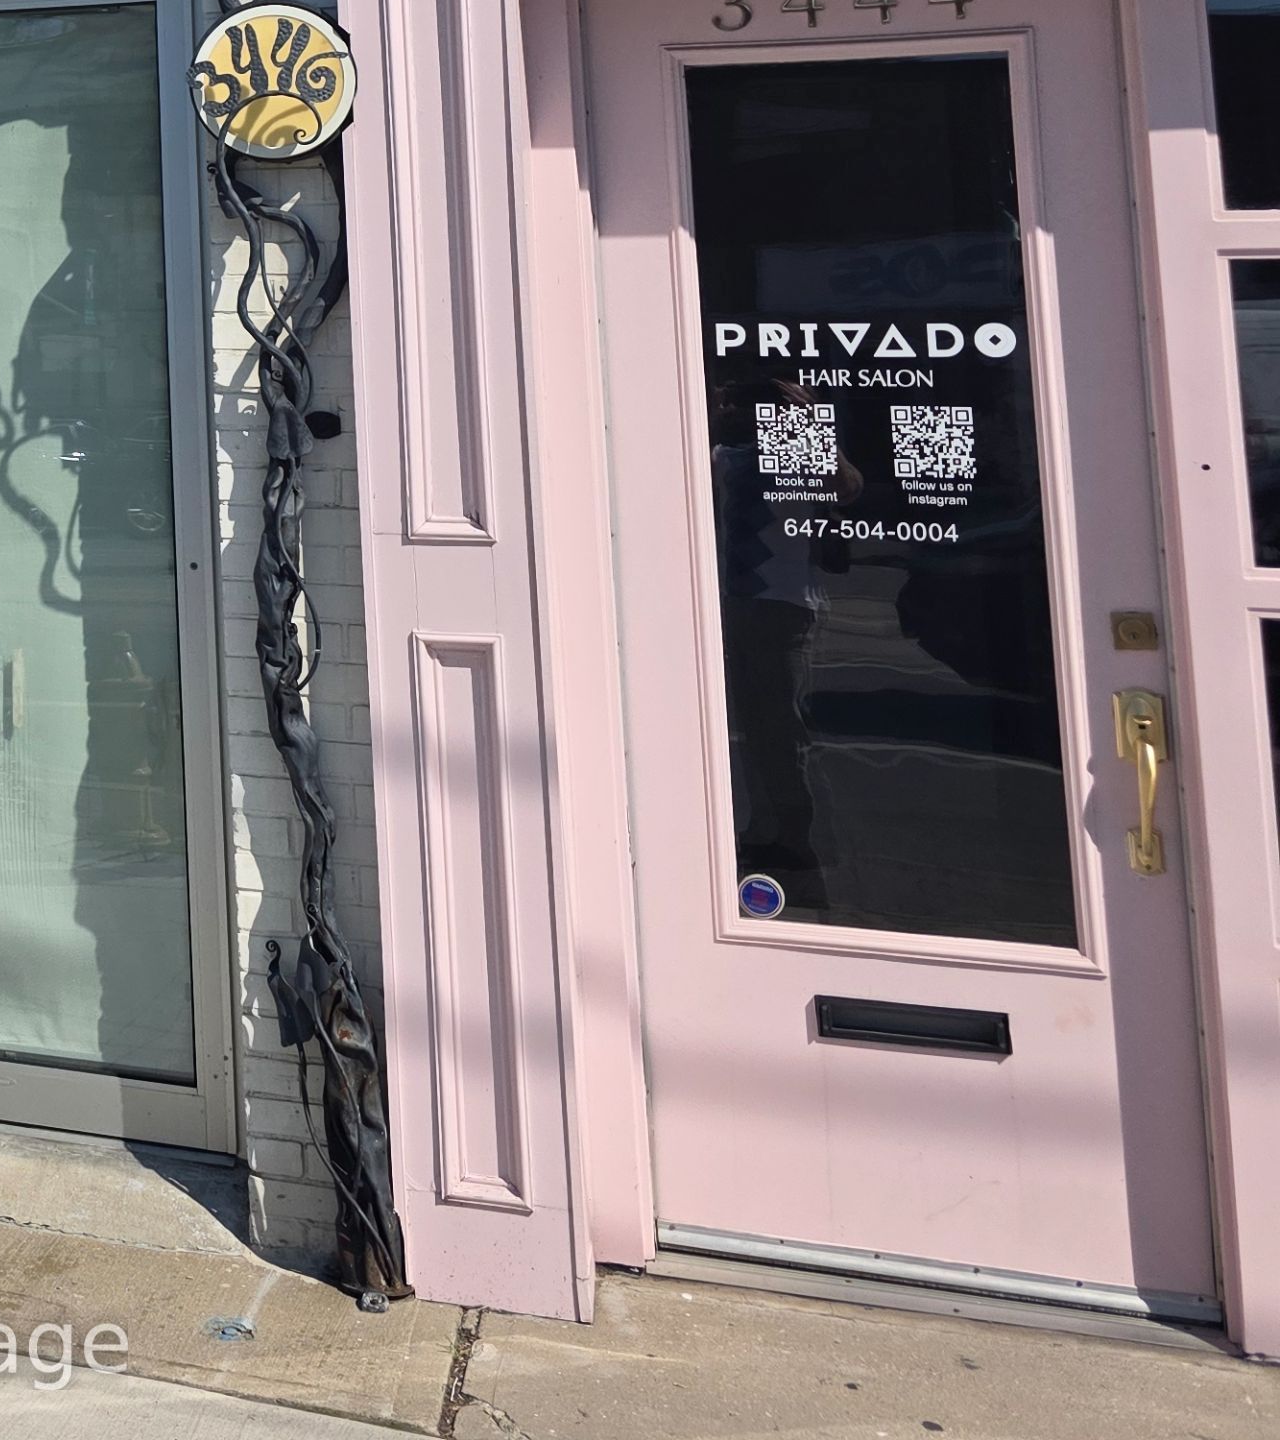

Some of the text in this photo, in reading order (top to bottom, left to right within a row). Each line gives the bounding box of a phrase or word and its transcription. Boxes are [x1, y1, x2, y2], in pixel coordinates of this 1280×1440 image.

[186, 18, 348, 117] 3446
[715, 322, 1017, 358] PRIVADO
[797, 368, 934, 388] HAIR SALON
[774, 475, 823, 487] book an
[901, 479, 973, 492] follow us on
[763, 490, 838, 502] appointment
[908, 494, 968, 507] instagram
[784, 518, 959, 543] 647-504-0004
